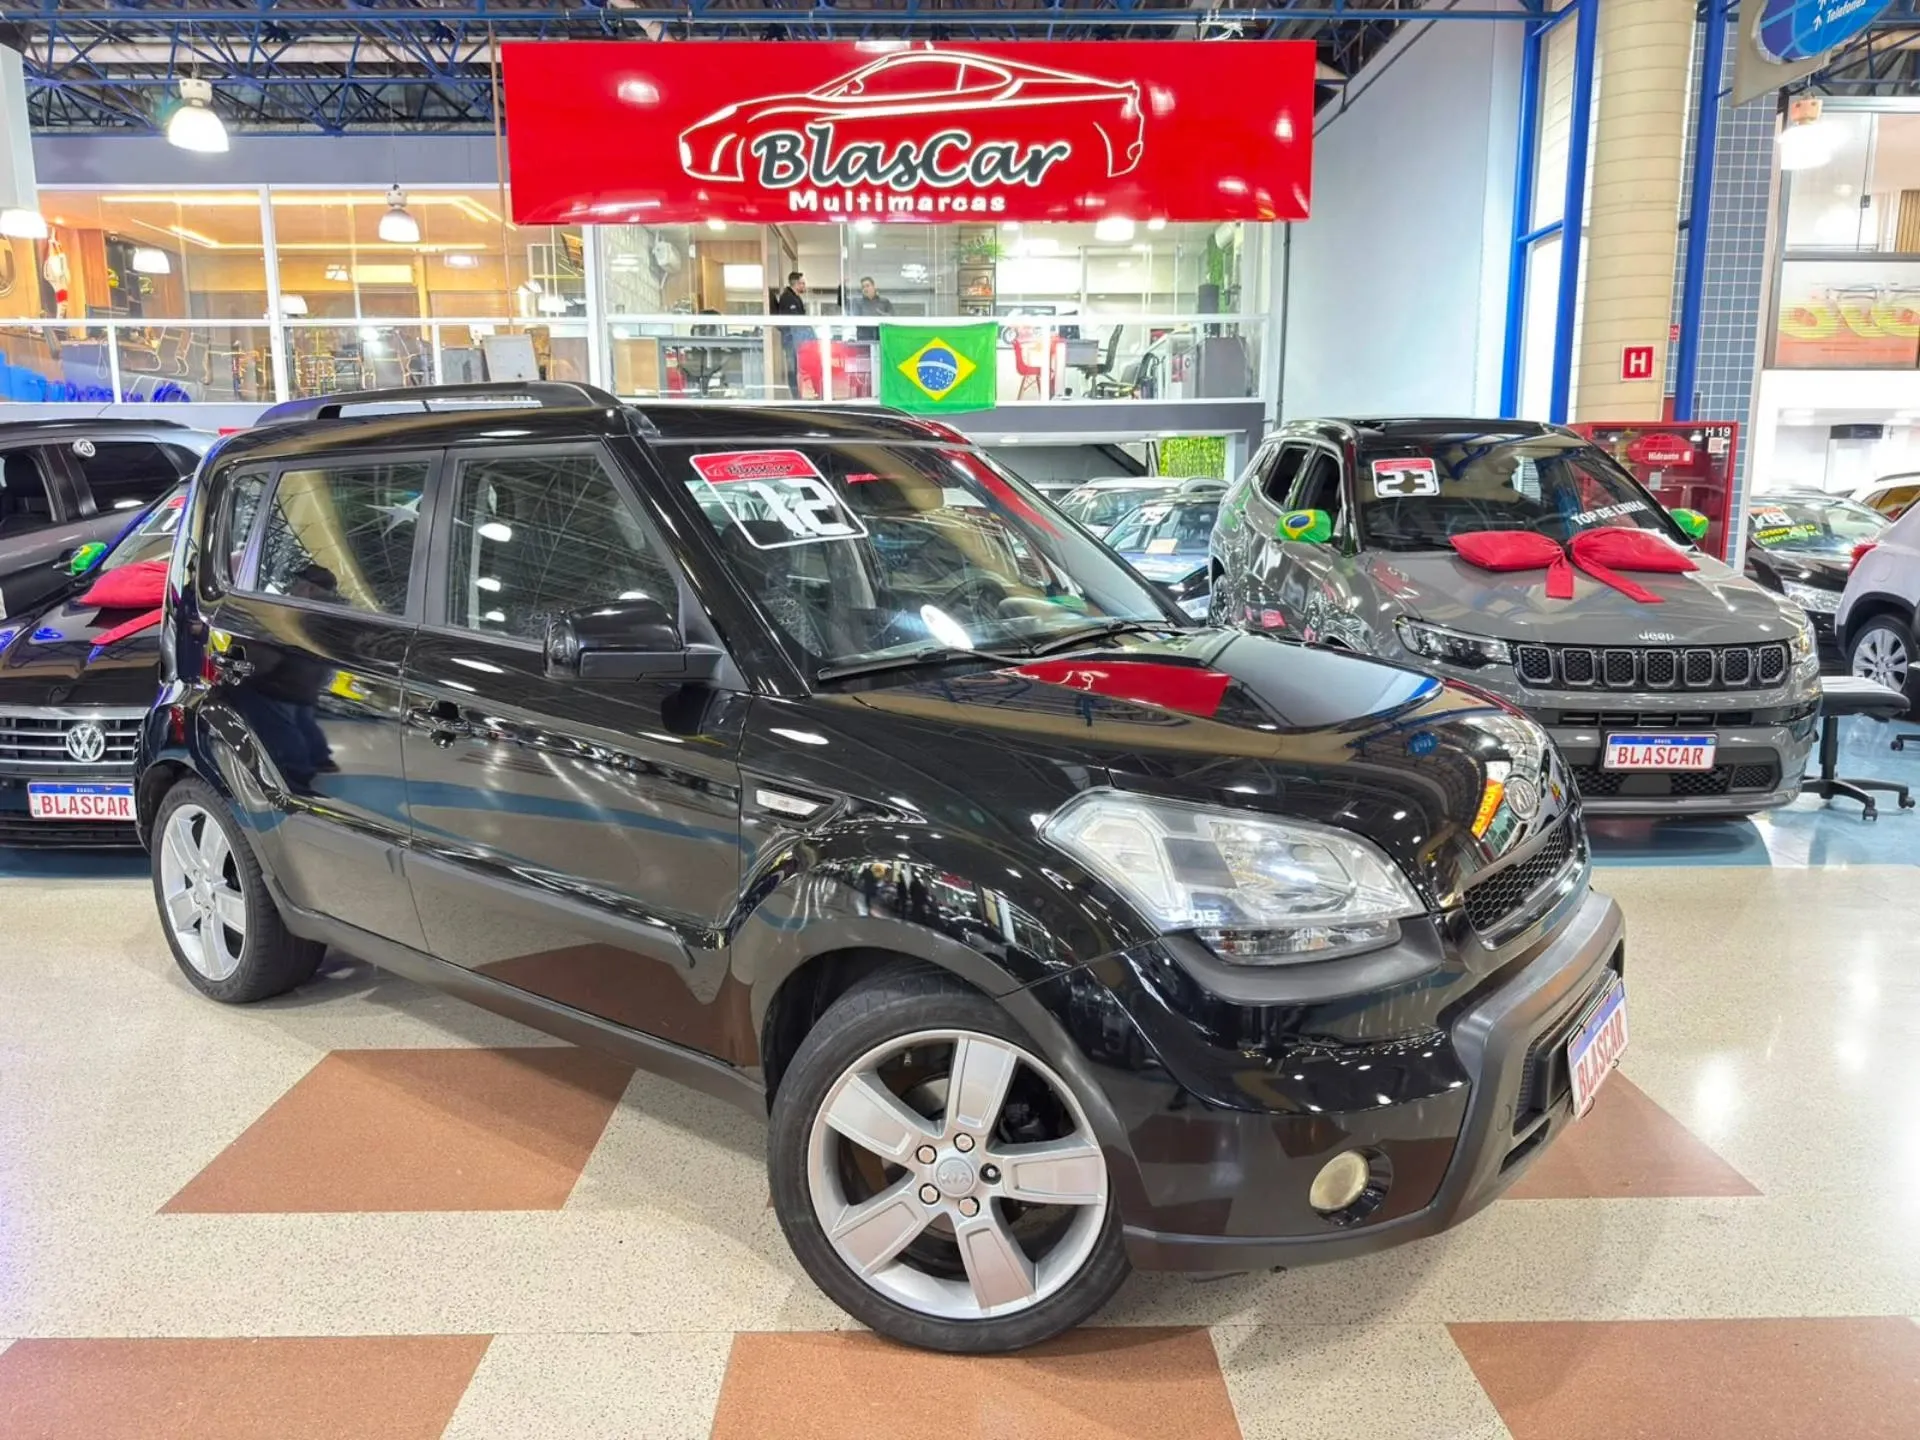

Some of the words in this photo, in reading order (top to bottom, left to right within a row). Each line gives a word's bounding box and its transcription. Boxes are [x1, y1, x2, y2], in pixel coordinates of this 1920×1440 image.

[752, 121, 1071, 192] BlasCar
[788, 190, 1006, 212] Multimarcas
[1629, 352, 1647, 374] H
[1705, 426, 1715, 437] H
[1718, 426, 1731, 437] 19
[1377, 470, 1436, 495] 23
[748, 477, 856, 538] 12
[1570, 510, 1598, 526] TOP
[1596, 506, 1616, 519] DE
[1611, 499, 1649, 516] LINHA
[1617, 746, 1704, 766] BLASCAR
[41, 795, 130, 816] BLASCAR
[1577, 1007, 1626, 1105] BLASCAR
